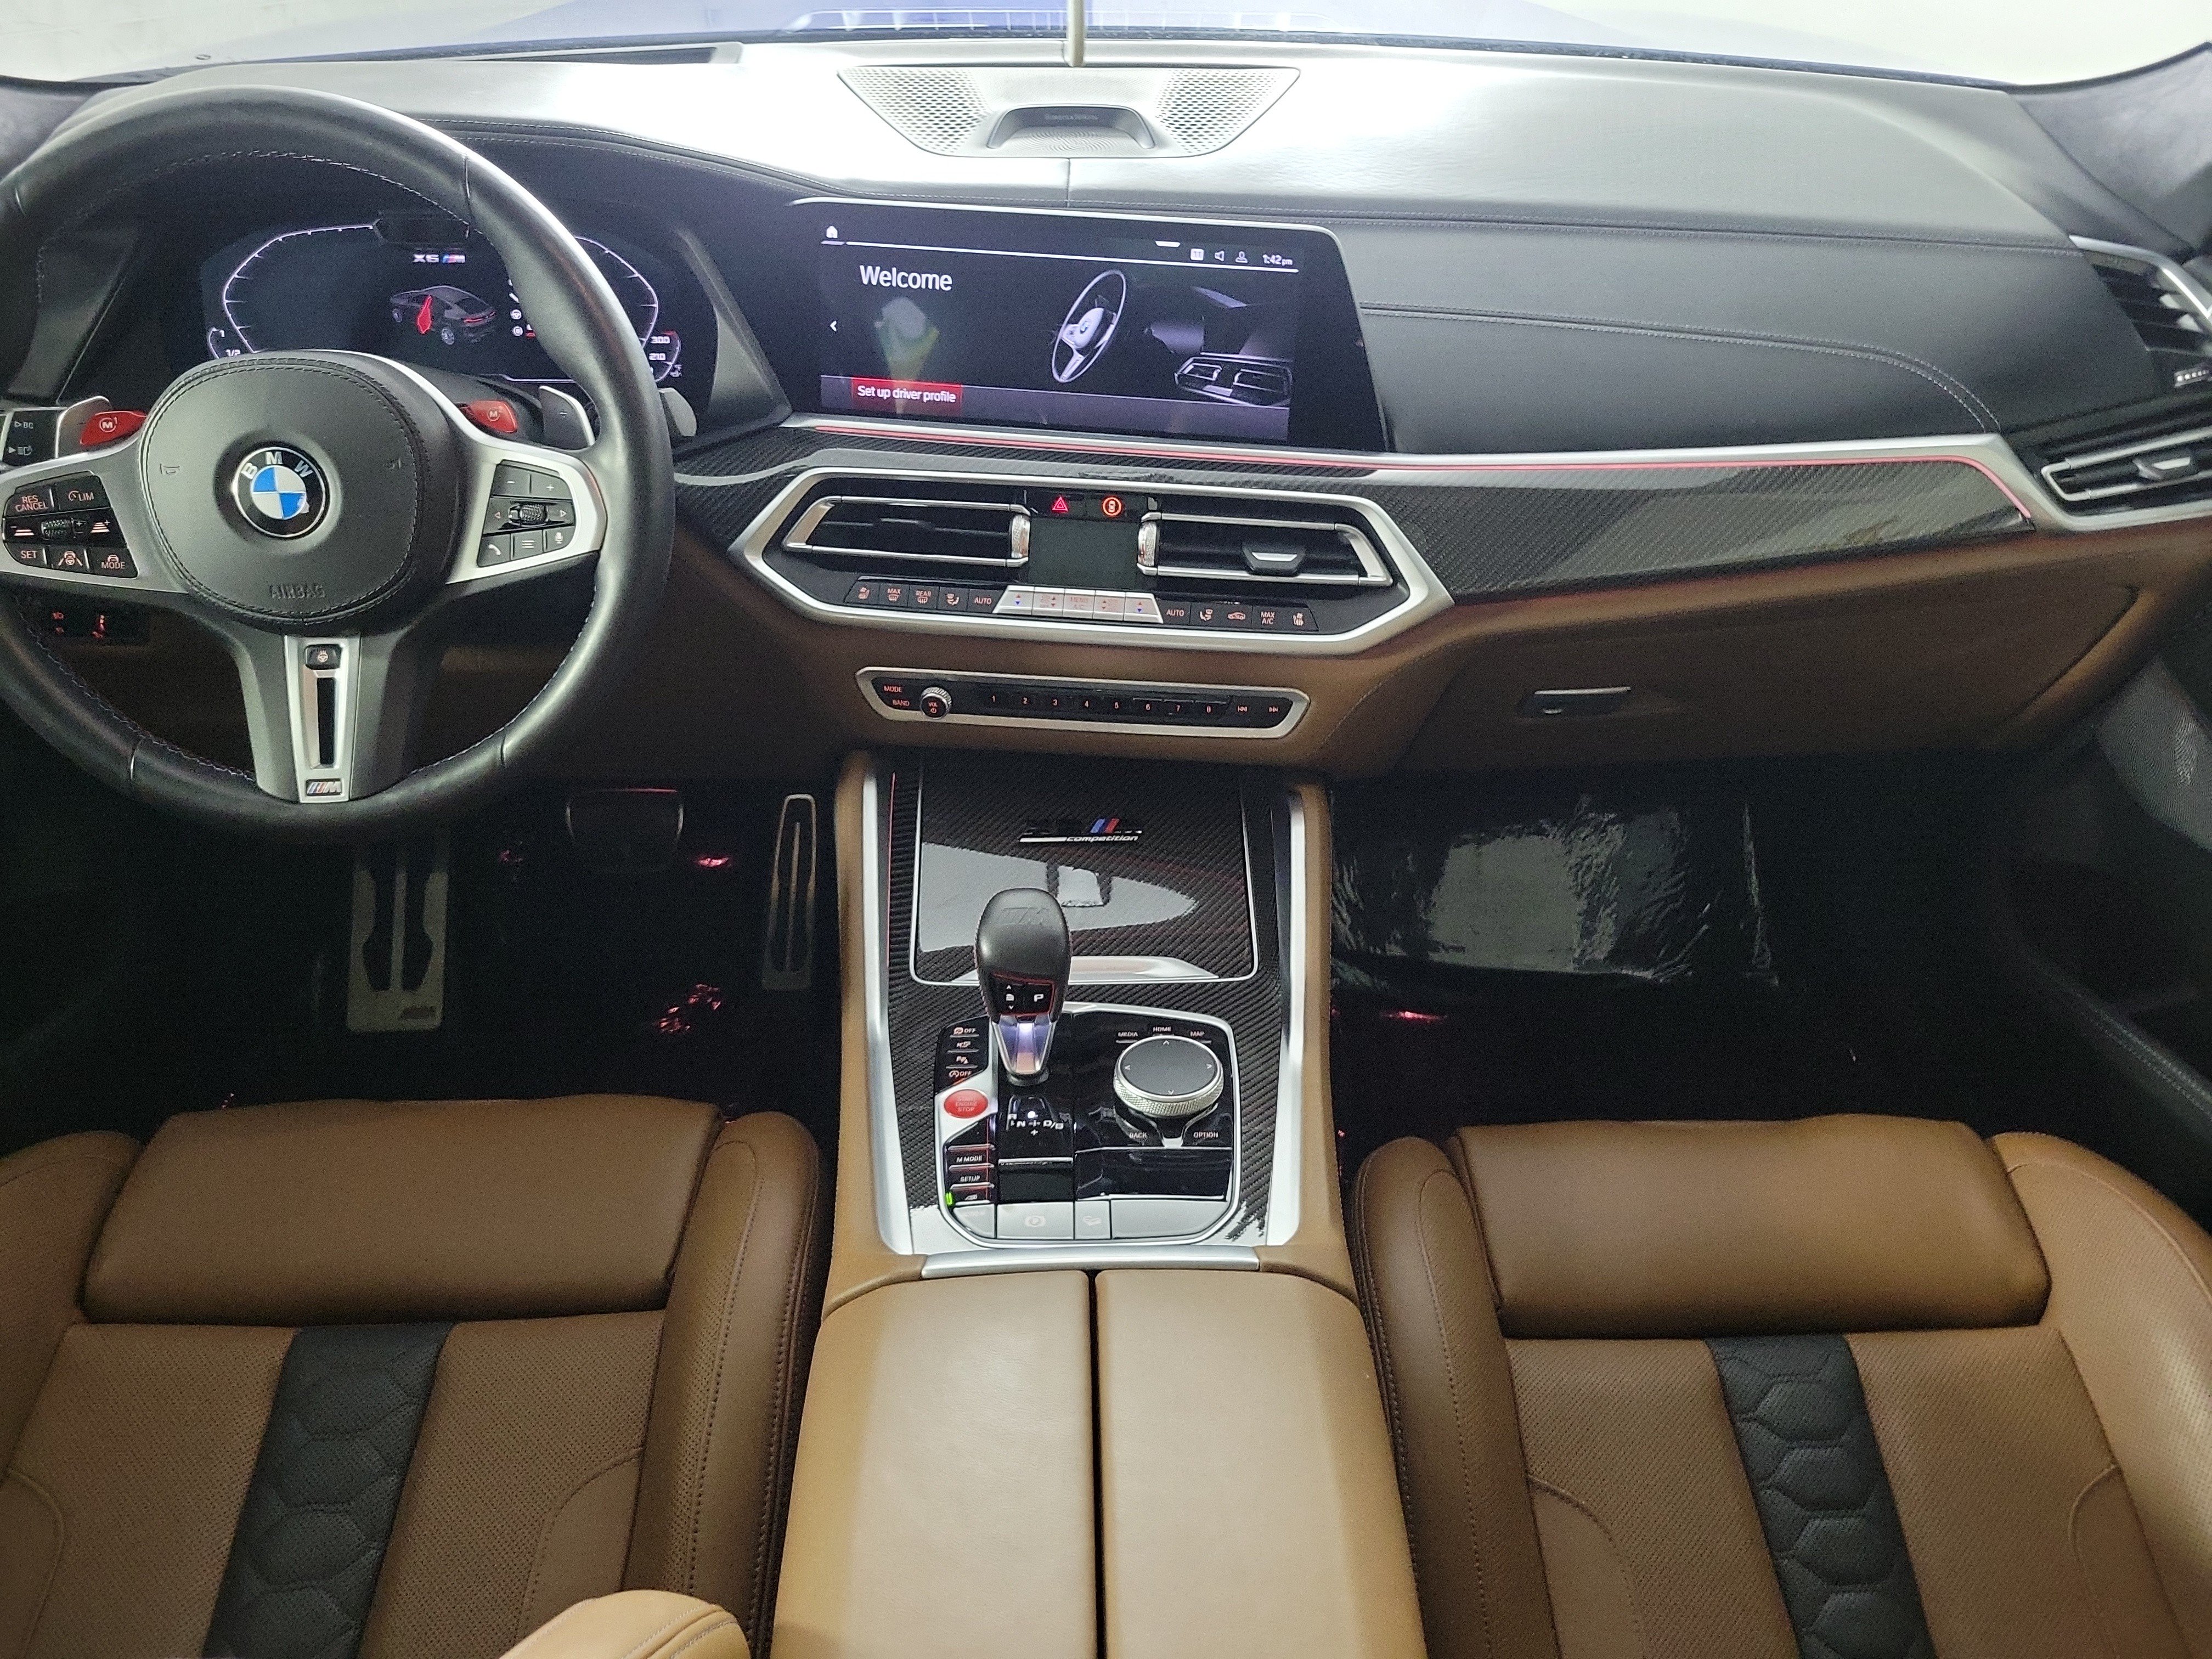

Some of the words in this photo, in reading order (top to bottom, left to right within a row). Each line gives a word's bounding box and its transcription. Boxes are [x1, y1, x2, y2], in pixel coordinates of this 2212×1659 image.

[413, 254, 438, 263] X6
[860, 265, 953, 291] Welcome
[650, 336, 670, 344] 300
[857, 385, 876, 397] Set
[877, 388, 891, 400] up
[892, 388, 922, 400] driver
[923, 391, 956, 403] profile
[241, 452, 313, 479] BMW
[22, 495, 38, 504] RES
[78, 492, 94, 501] LIM
[15, 502, 49, 512] CANCEL
[21, 550, 37, 559] SET
[974, 596, 992, 605] AUTO
[1034, 994, 1044, 1002] P
